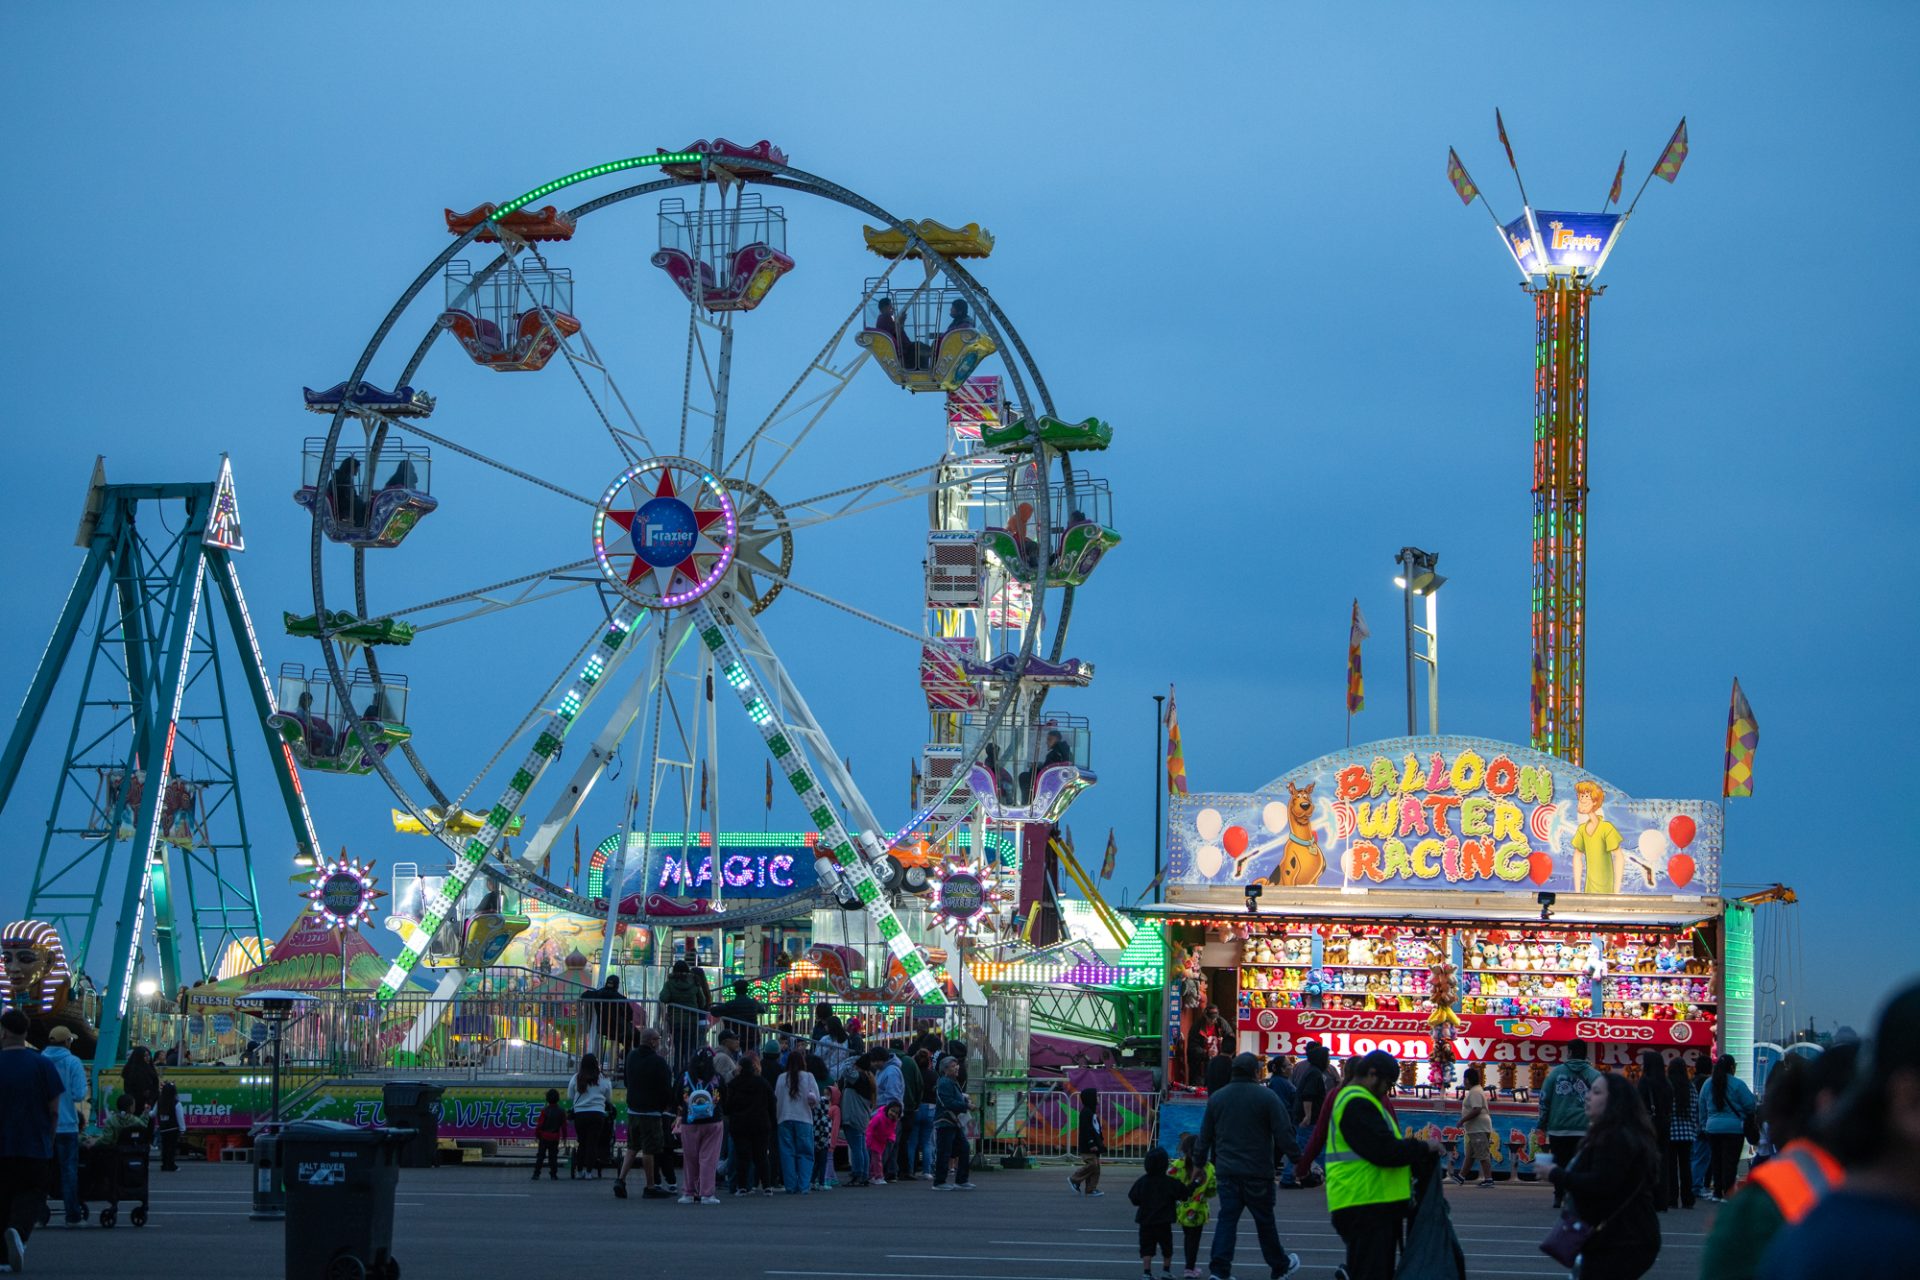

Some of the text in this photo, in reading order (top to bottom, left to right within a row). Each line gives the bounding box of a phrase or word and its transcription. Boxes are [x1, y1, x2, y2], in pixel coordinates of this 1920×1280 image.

[646, 524, 694, 547] Frazier
[1335, 750, 1553, 806] BALLOON
[1358, 793, 1530, 846] WATER
[659, 854, 795, 888] MAGIC
[1350, 835, 1533, 883] RACING
[192, 994, 231, 1007] FRESH
[1304, 1013, 1472, 1034] Dutchmas
[1576, 1021, 1654, 1040] Store
[1265, 1031, 1430, 1059] Balloon
[455, 1100, 546, 1129] WHEE
[320, 1162, 345, 1170] RIVER
